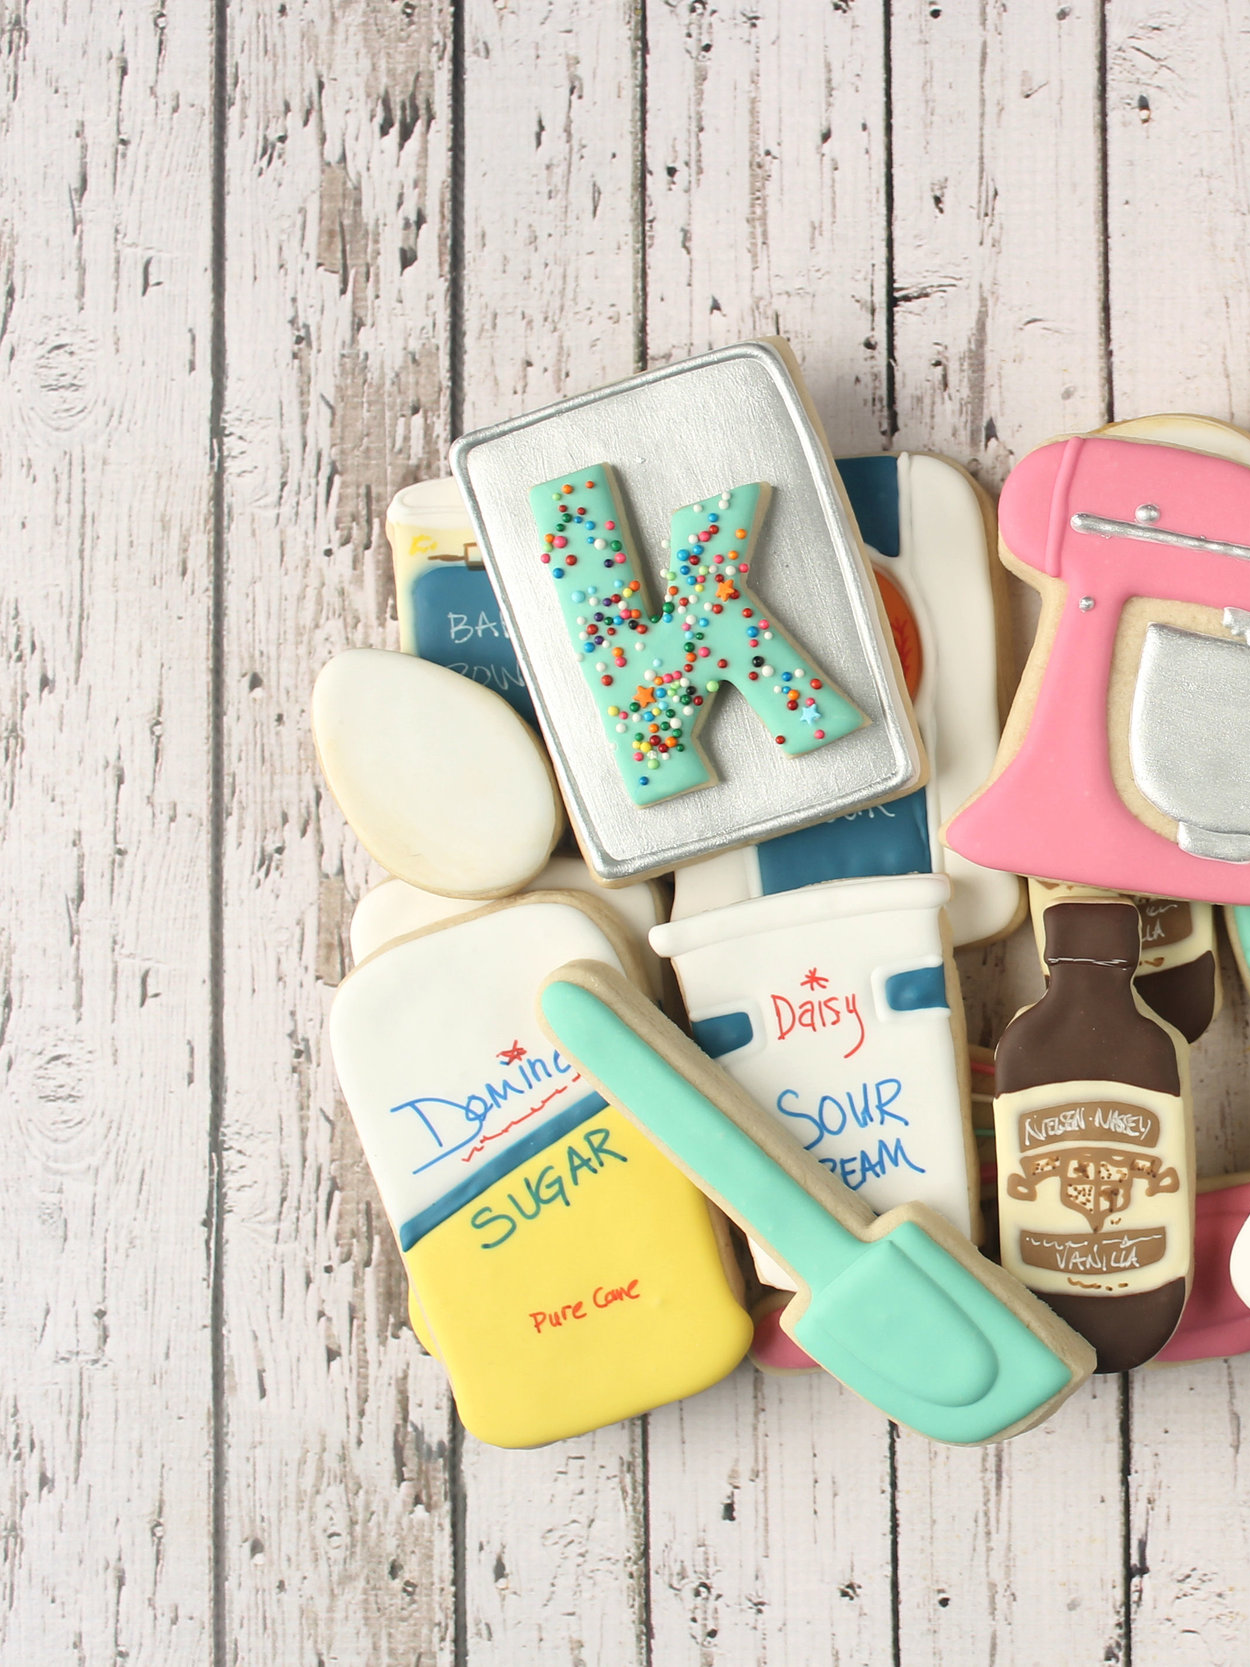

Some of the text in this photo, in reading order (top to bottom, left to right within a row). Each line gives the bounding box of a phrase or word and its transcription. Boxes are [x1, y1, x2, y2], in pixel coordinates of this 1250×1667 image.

[529, 462, 872, 808] K
[771, 993, 865, 1059] Daisy
[777, 1078, 909, 1151] SOUR
[471, 1128, 628, 1250] SUGAR
[1056, 1244, 1140, 1271] VANILLA
[529, 1301, 587, 1333] Pure
